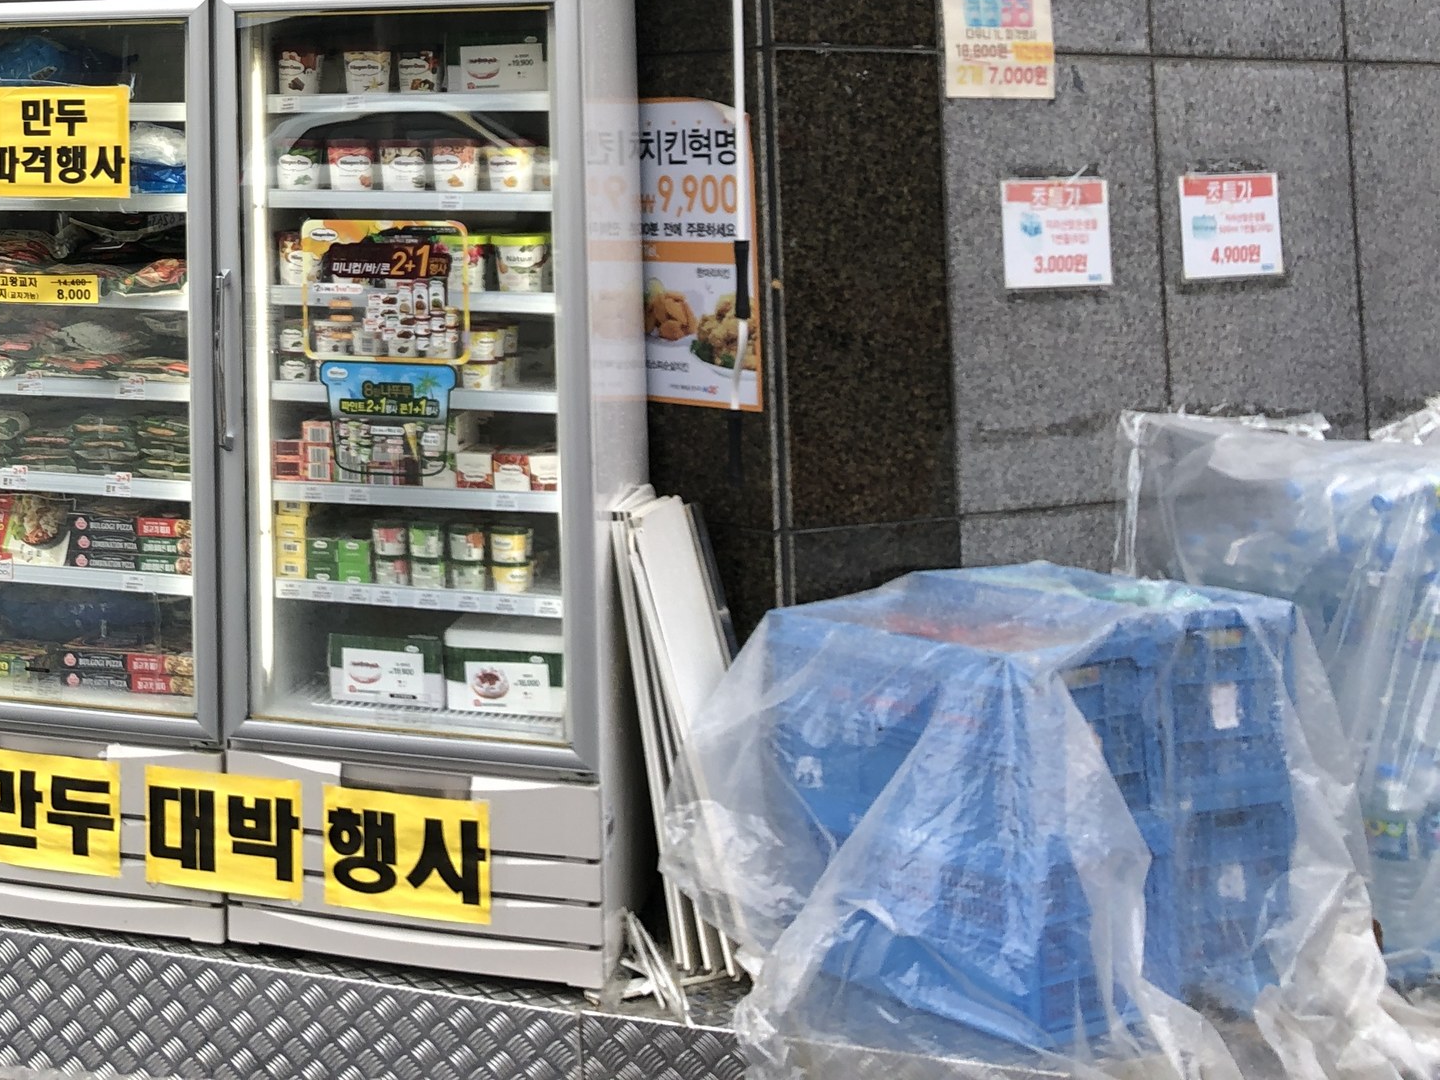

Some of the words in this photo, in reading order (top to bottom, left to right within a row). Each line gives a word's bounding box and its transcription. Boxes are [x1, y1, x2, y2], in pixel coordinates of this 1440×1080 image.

[21, 98, 87, 137] 만두
[640, 128, 737, 166] 치킨혁명
[57, 289, 91, 301] 8,000
[89, 521, 116, 530] BULGOGI
[116, 522, 134, 531] PIZZA
[79, 657, 105, 667] BULGOGI
[105, 659, 123, 668] PIZZA
[147, 783, 302, 883] 대박
[327, 806, 487, 905] 행사
